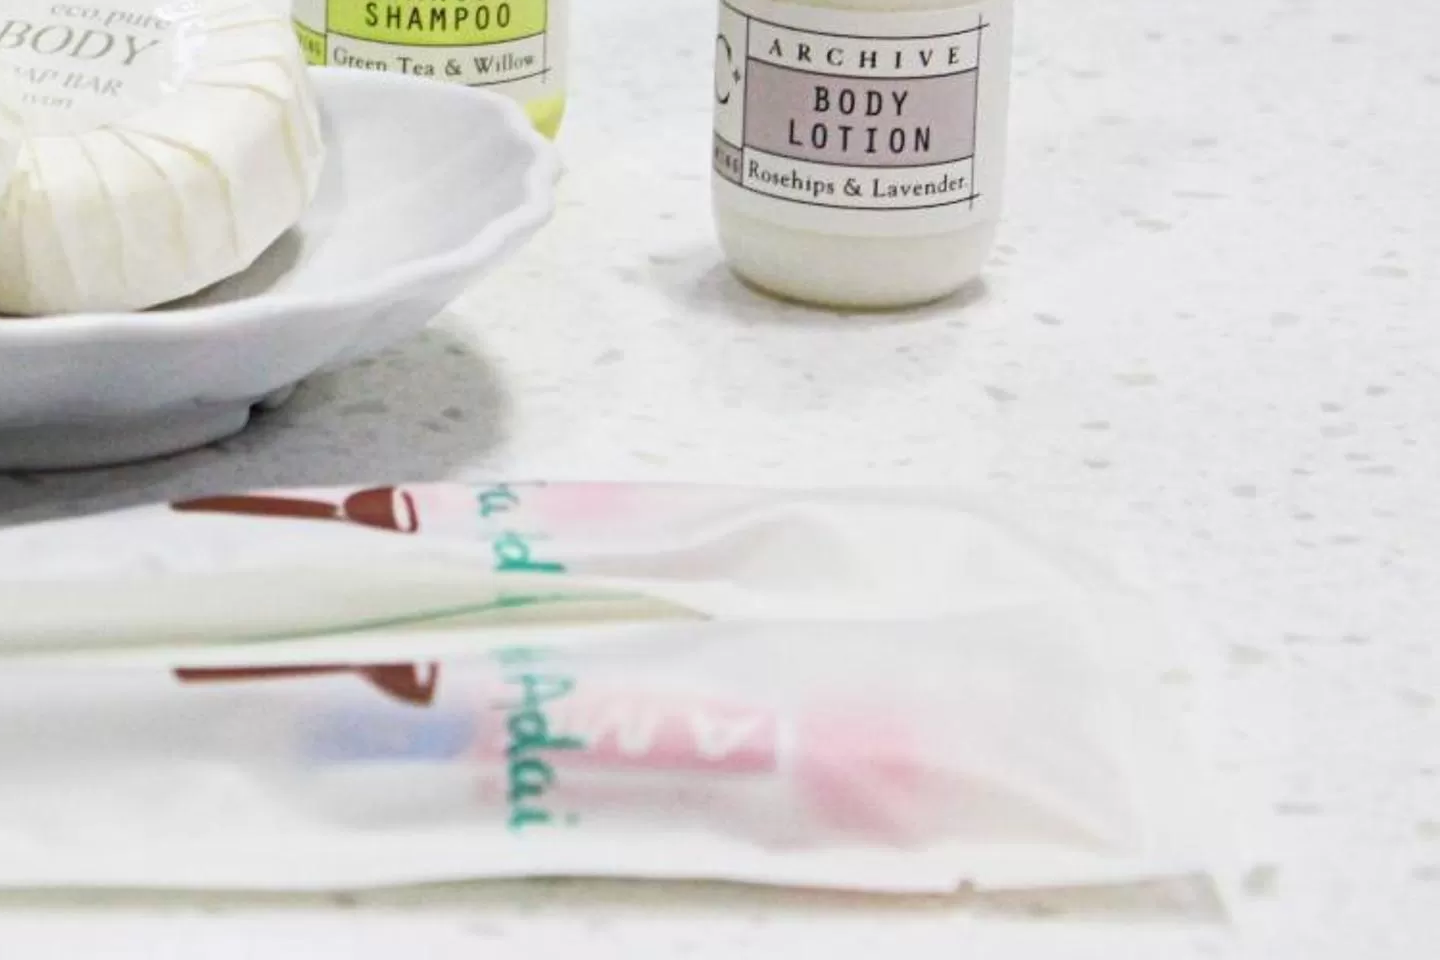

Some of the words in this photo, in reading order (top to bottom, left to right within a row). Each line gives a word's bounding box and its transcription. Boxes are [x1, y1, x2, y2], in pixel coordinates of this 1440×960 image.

[364, 2, 512, 32] SHAMPOO
[333, 46, 388, 73] Green
[396, 55, 435, 77] Tea
[444, 58, 463, 77] &
[472, 52, 536, 76] Willow
[768, 38, 962, 69] ARCHIVE
[62, 71, 124, 98] BAR
[812, 86, 909, 117] BODY
[788, 118, 932, 154] LOTION
[747, 159, 836, 198] Rosehips
[843, 178, 863, 198] &
